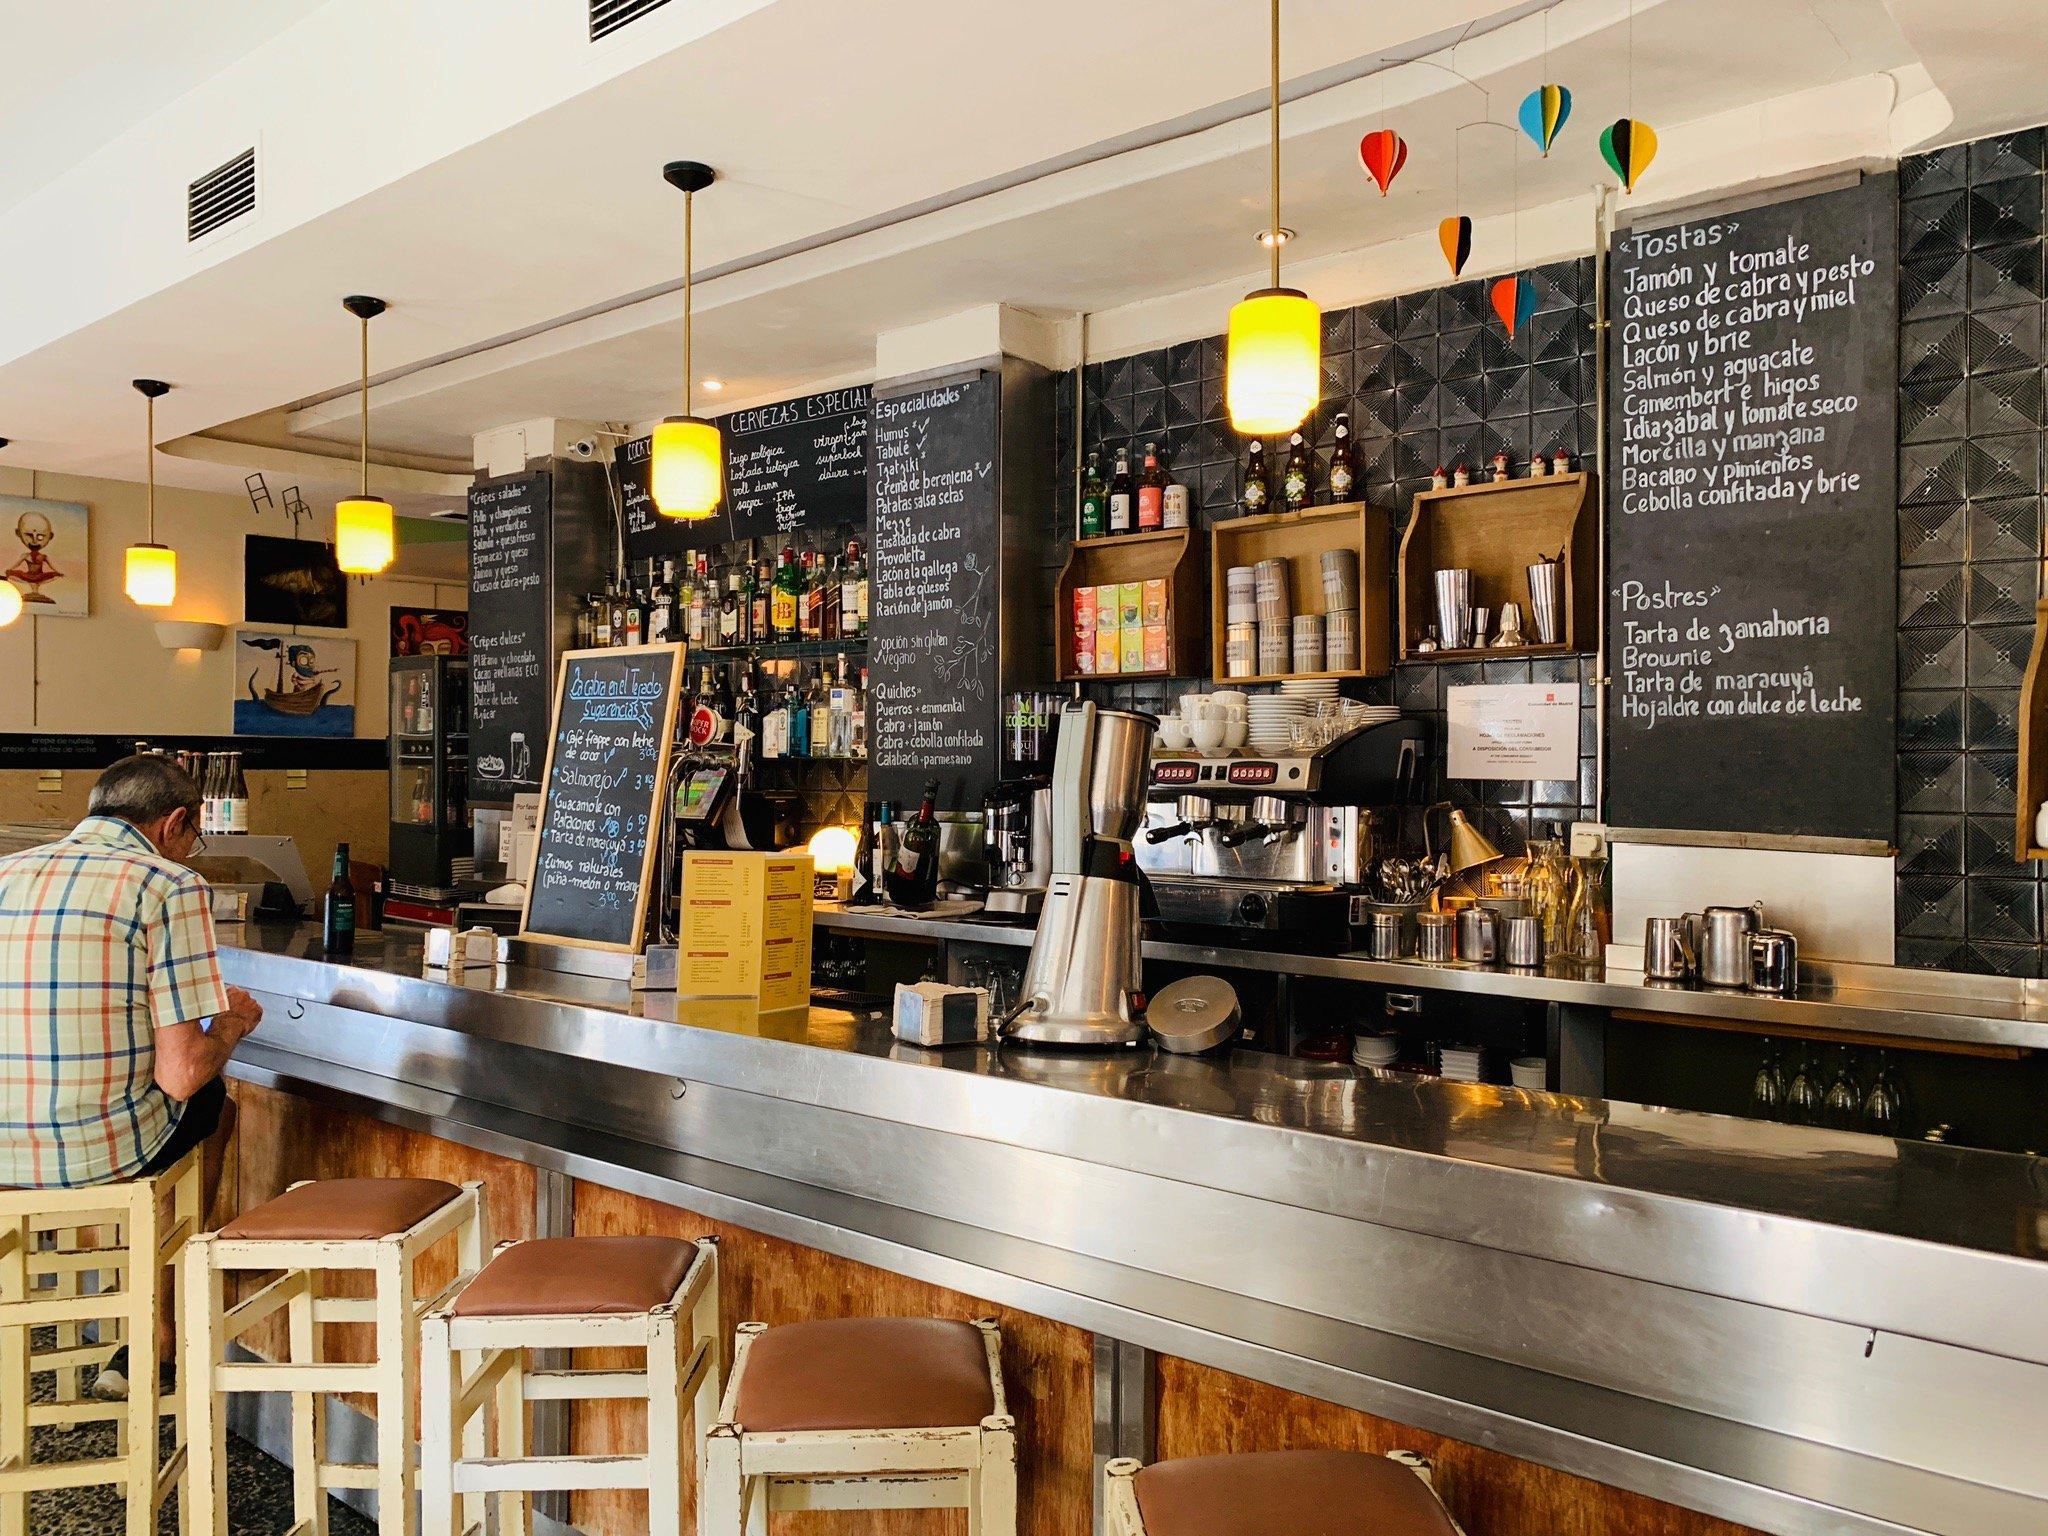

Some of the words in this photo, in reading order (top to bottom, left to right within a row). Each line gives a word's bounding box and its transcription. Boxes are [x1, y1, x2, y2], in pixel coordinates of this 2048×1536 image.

[1623, 263, 1693, 295] Jamón
[1703, 261, 1717, 286] y
[1729, 234, 1810, 275] tomate
[1623, 293, 1690, 319] Queso
[1695, 282, 1721, 306] de
[1724, 272, 1791, 301] cabra
[1795, 271, 1809, 295] y
[1812, 254, 1875, 293] pesto
[1622, 317, 1691, 344] Queso
[1696, 309, 1721, 332] de
[1724, 299, 1790, 326] cabra
[1794, 297, 1807, 324] y
[1810, 279, 1855, 312] miel
[1622, 340, 1680, 368] Lacón
[1688, 340, 1699, 364] y
[1705, 330, 1751, 356] brie
[1622, 366, 1696, 393] Salmón
[1702, 365, 1714, 385] y
[1724, 339, 1814, 386] aguacate
[1623, 378, 1731, 416] Camembert
[1740, 383, 1752, 401] e
[1764, 369, 1820, 405] higos
[731, 403, 798, 433] CERVEZAS
[806, 388, 867, 417] ESPECIAL
[1622, 406, 1718, 446] Idiazábal
[1724, 409, 1735, 435] y
[1741, 398, 1807, 427] tomate
[1810, 395, 1858, 417] seco
[876, 426, 909, 443] Humus
[1622, 437, 1707, 466] Morcilla
[1711, 437, 1727, 461] y
[1733, 426, 1825, 453] manzana
[729, 449, 748, 467] trigo
[876, 440, 909, 459] Tabulé
[731, 463, 763, 480] tostada
[1622, 467, 1697, 491] Bacalao
[1703, 465, 1717, 487] y
[1723, 454, 1814, 486] pimientos
[776, 489, 795, 502] IPA
[876, 480, 908, 496] Crema
[909, 473, 920, 491] de
[1622, 487, 1693, 515] Cebolla
[1698, 477, 1795, 506] confitada
[1797, 479, 1813, 504] y
[1817, 468, 1861, 494] brie
[877, 495, 912, 514] Patatas
[914, 489, 936, 509] salsa
[939, 485, 963, 505] setas
[876, 528, 916, 549] Ensalada
[918, 525, 930, 542] de
[933, 522, 960, 541] cabra
[876, 566, 903, 583] Lacón
[905, 569, 909, 579] a
[911, 563, 920, 578] la
[922, 560, 957, 584] gallega
[877, 582, 903, 599] Tabla
[905, 581, 915, 596] de
[917, 582, 950, 601] quesos
[877, 600, 909, 617] Ración
[911, 601, 921, 613] de
[923, 596, 952, 618] jamón
[1623, 620, 1678, 644] Tarta
[1686, 617, 1711, 641] de
[882, 652, 916, 672] vegano
[1623, 646, 1712, 669] Brownie
[526, 664, 538, 677] ECO
[1623, 670, 1675, 694] Tarta
[1680, 670, 1703, 693] de
[1716, 665, 1814, 695] maracuyá
[876, 702, 912, 716] Puerros
[922, 696, 965, 713] emmental
[1622, 694, 1700, 729] Hojaldre
[1707, 699, 1735, 715] con
[1737, 691, 1781, 715] dulce
[1786, 691, 1806, 714] de
[1810, 686, 1862, 714] leche
[567, 729, 585, 748] Café
[876, 718, 905, 733] Cabra
[913, 718, 943, 736] jamón
[876, 735, 903, 749] Cabra
[911, 732, 942, 748] cebolla
[565, 746, 576, 759] de
[876, 751, 918, 766] Calabacín
[924, 755, 972, 769] parmesano
[560, 765, 612, 798] Salmorejo
[555, 793, 601, 814] Guacamole
[604, 803, 620, 816] con
[553, 811, 596, 832] Patacones
[551, 830, 573, 844] Tarta
[575, 833, 585, 846] de
